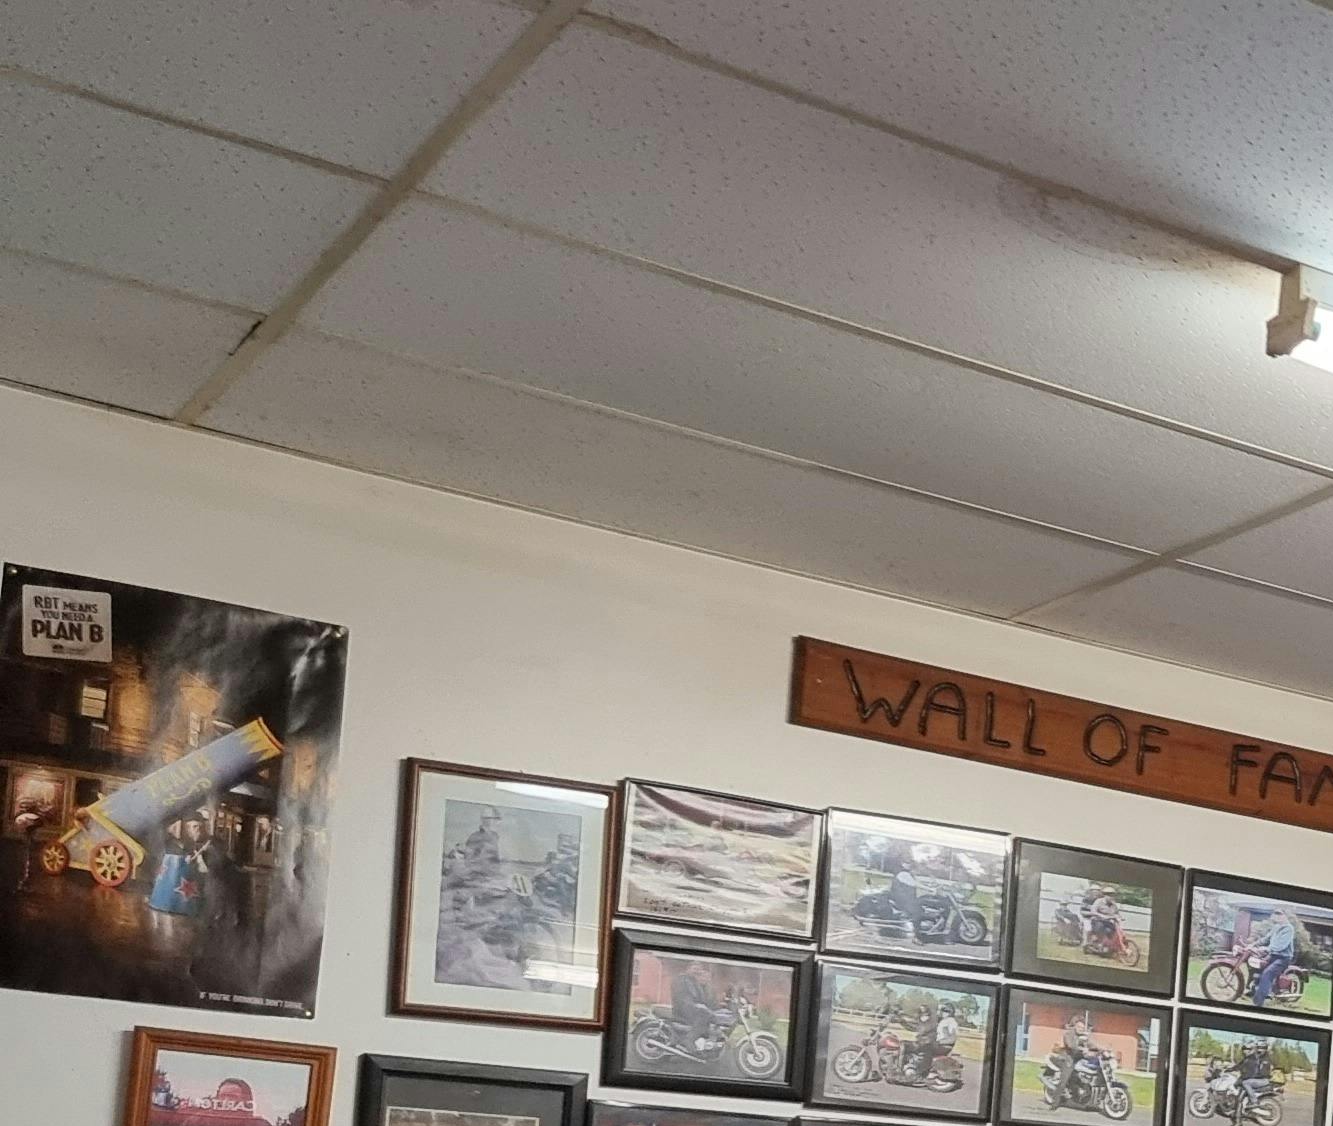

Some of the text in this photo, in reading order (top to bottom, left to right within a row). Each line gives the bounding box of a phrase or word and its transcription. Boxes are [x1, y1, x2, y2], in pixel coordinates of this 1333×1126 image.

[34, 595, 98, 614] RBT MEANS
[41, 610, 94, 622] YOU NEED A
[31, 619, 104, 643] PLAN B
[843, 658, 1046, 757] WALL
[1083, 713, 1169, 776] OF
